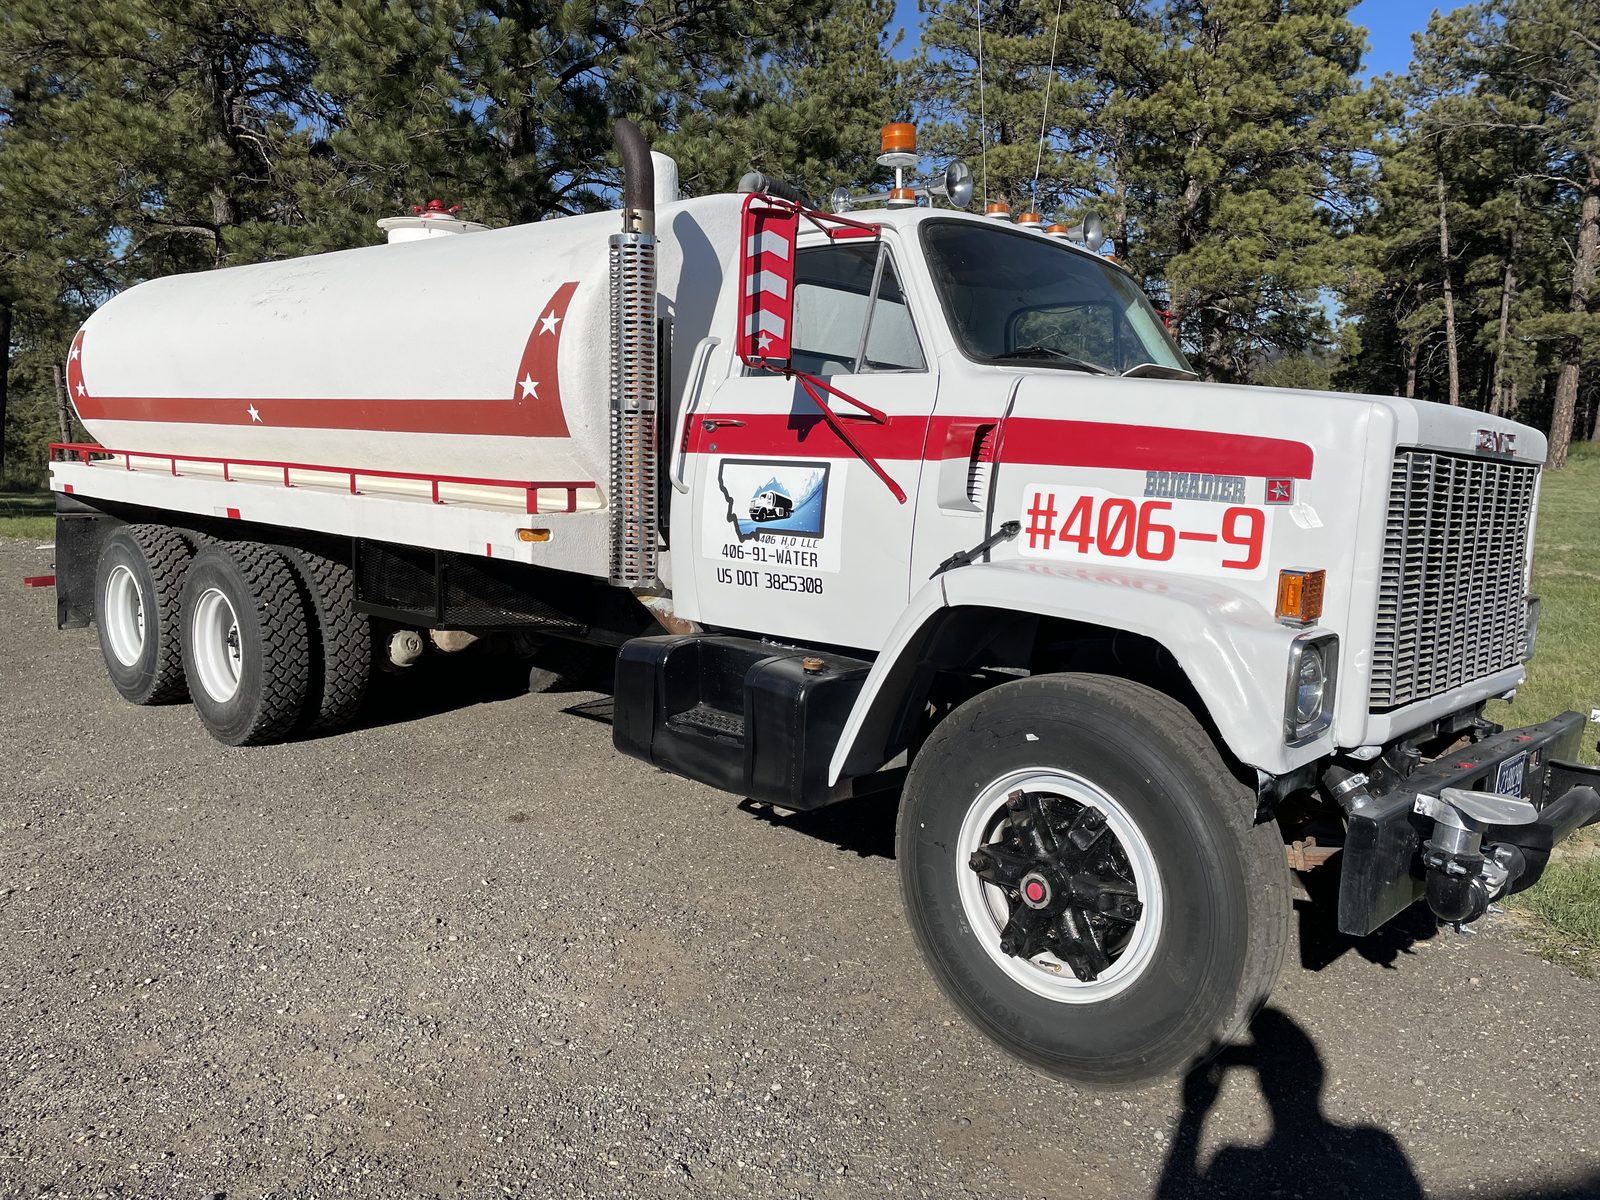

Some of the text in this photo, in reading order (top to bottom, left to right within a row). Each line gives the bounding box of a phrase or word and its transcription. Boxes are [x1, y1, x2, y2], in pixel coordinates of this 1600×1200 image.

[1143, 470, 1247, 504] BRIGADIER
[759, 535, 776, 544] 406
[801, 538, 819, 548] LLC
[1025, 492, 1266, 570] #406-9
[721, 544, 819, 568] 406-91-WATER
[717, 568, 823, 594] US DOT 3825308
